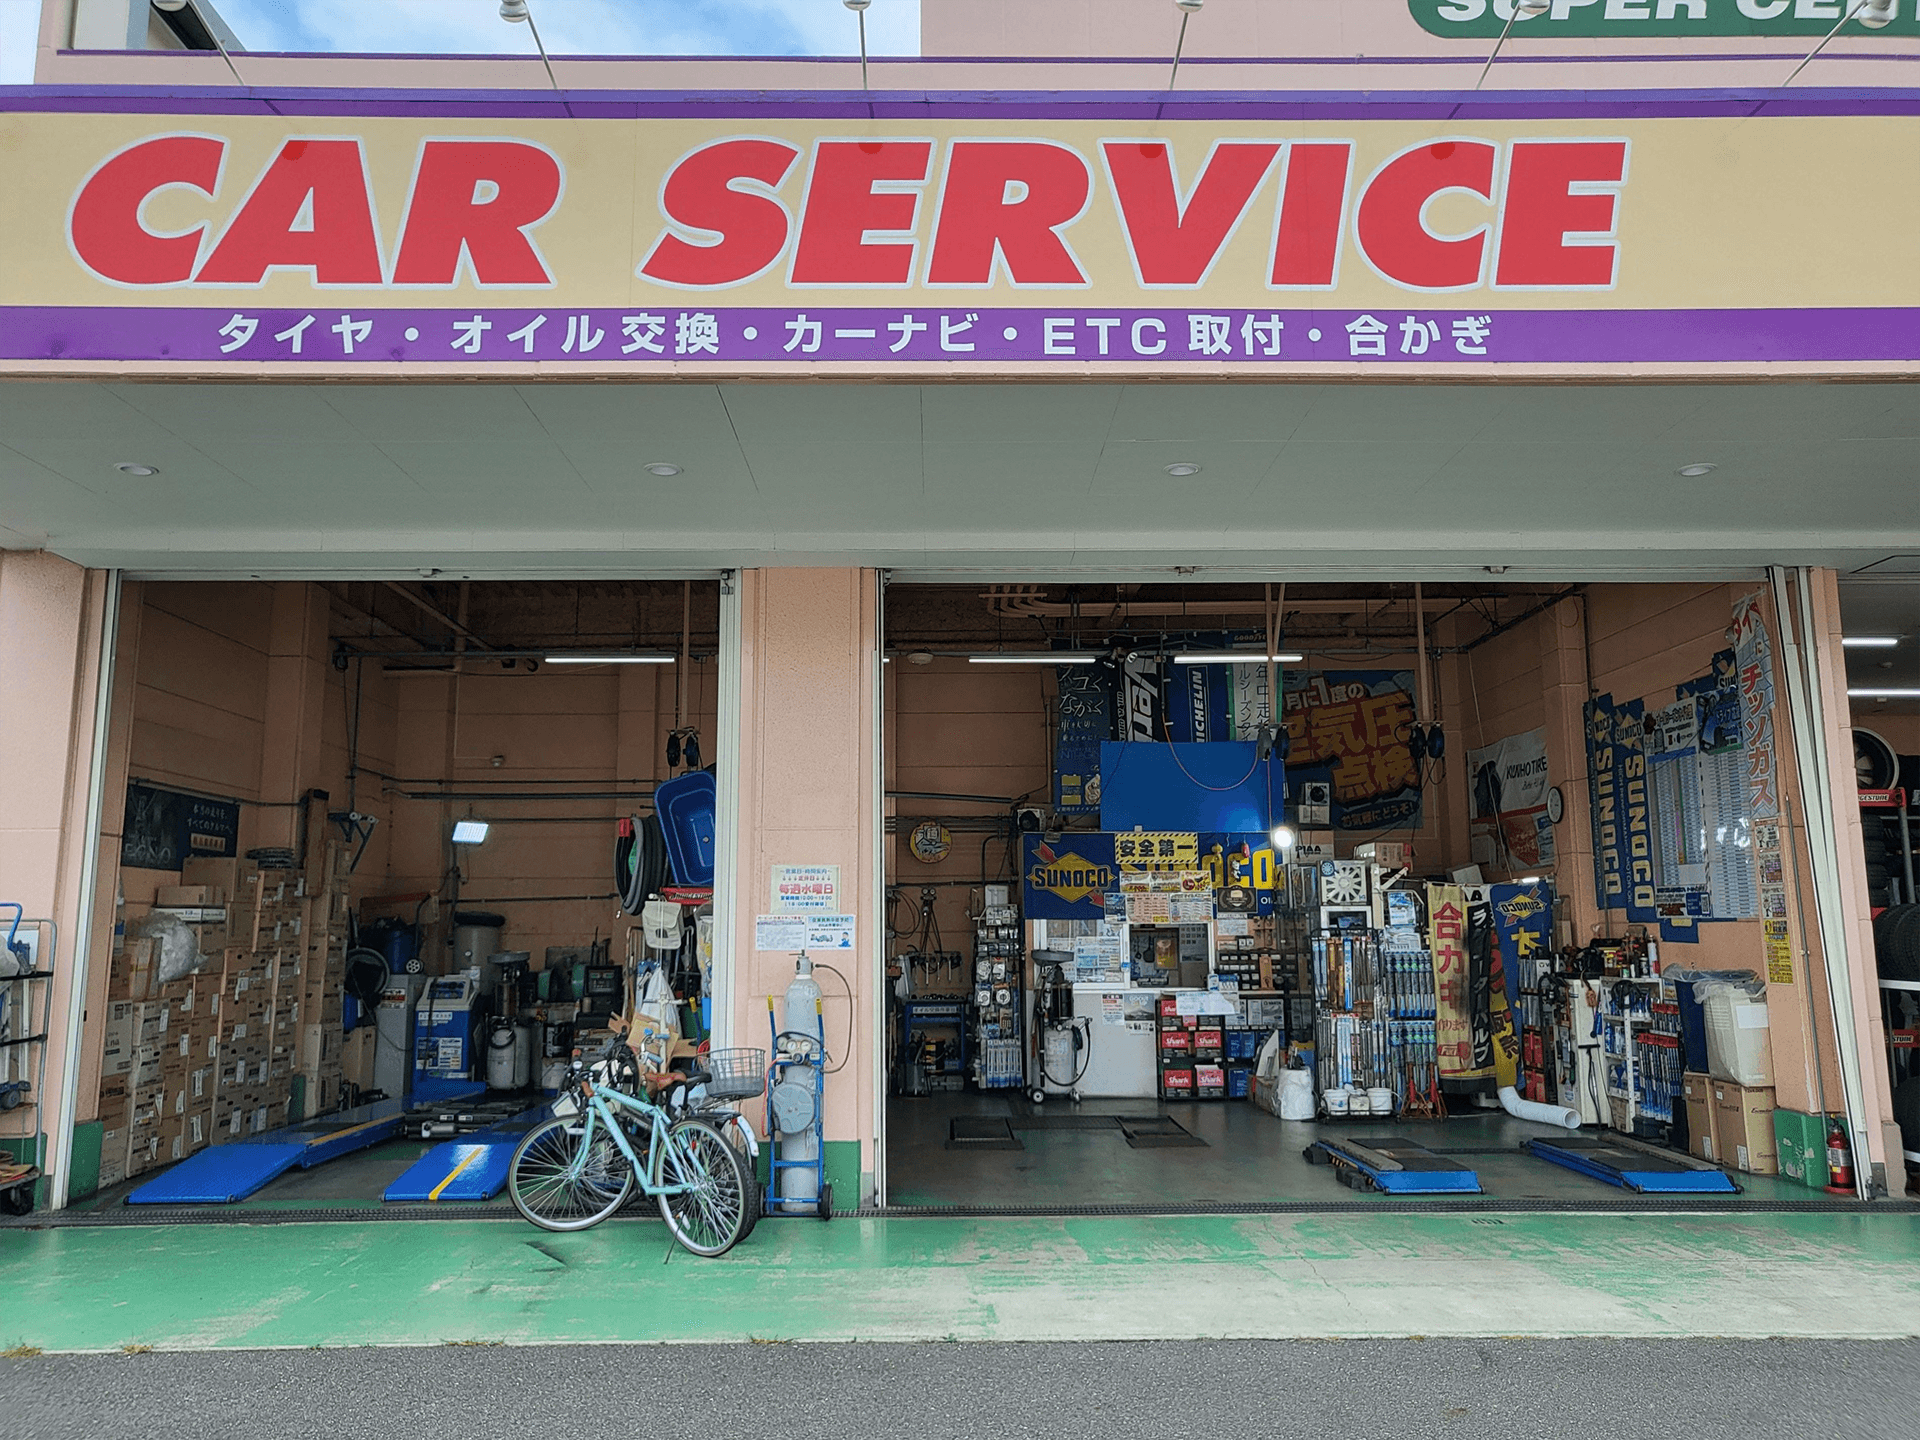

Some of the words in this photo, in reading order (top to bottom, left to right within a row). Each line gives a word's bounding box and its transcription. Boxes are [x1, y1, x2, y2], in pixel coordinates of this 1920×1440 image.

[67, 132, 564, 288] CAR
[637, 133, 1631, 289] SERVICE
[1285, 677, 1364, 711] 月に1度の
[1615, 722, 1642, 742] SUNOCO
[1596, 747, 1622, 894] SUNOCO
[1624, 754, 1655, 908] SUNOCO
[1120, 839, 1193, 857] 安全第一
[1295, 845, 1322, 855] PIAA
[1034, 867, 1108, 887] SUNOCO
[779, 883, 833, 894] 毎週水曜日
